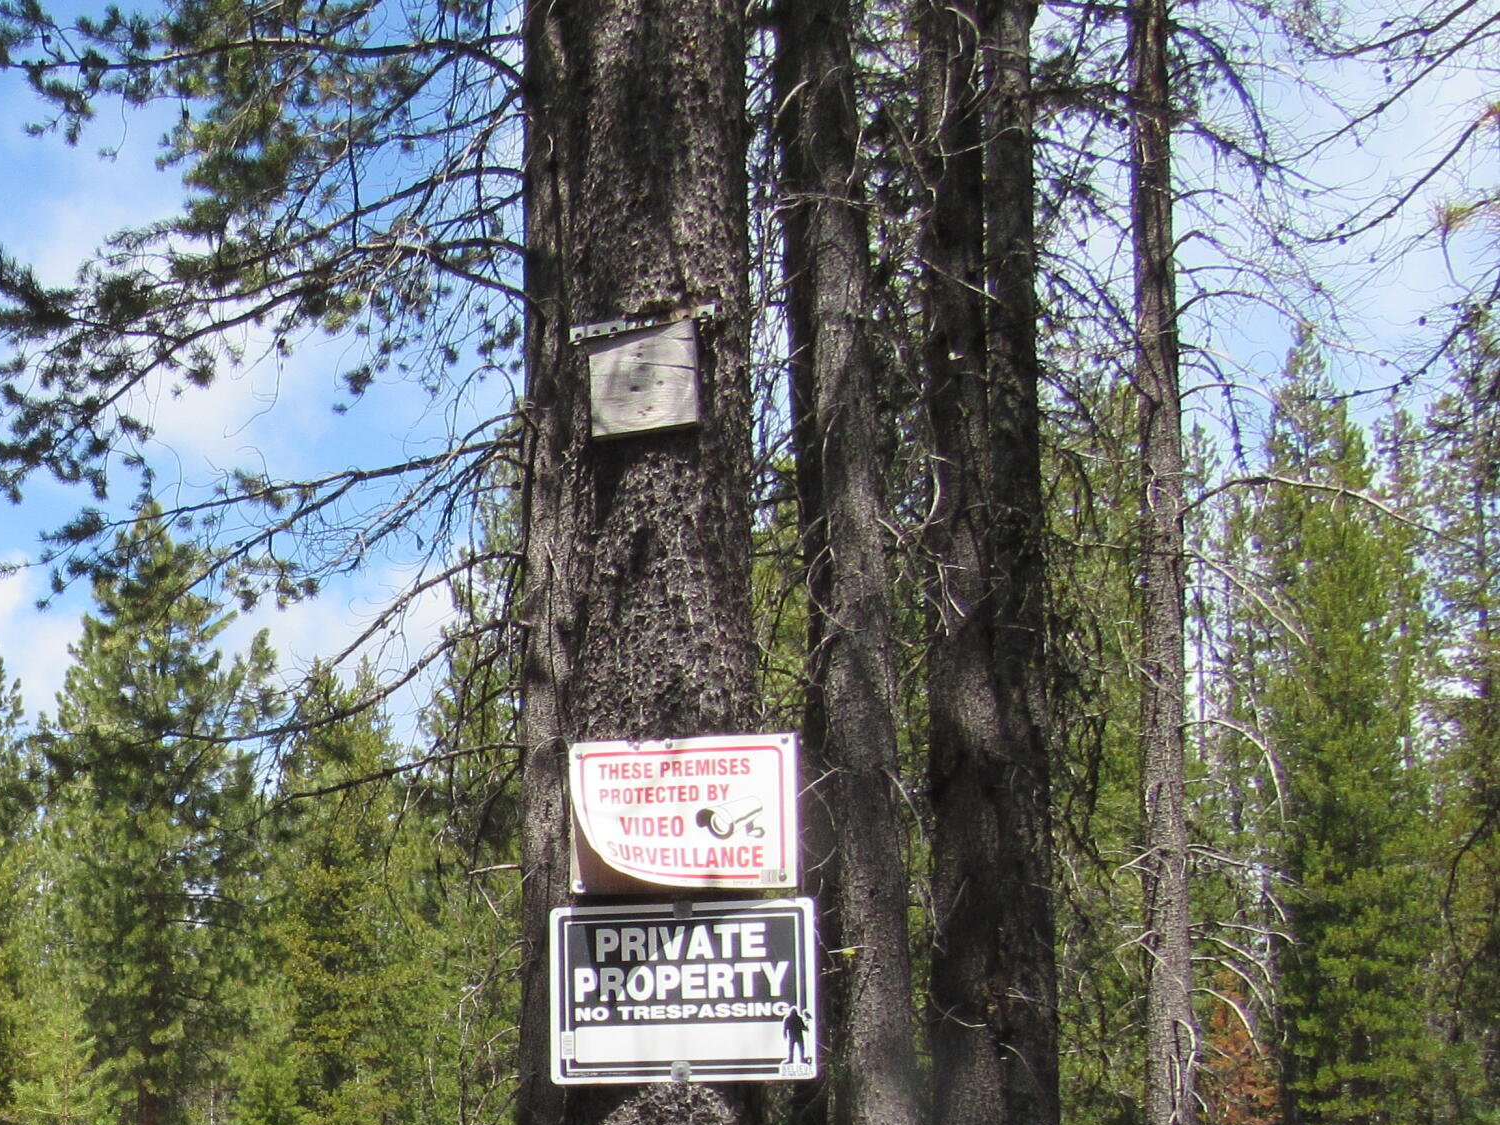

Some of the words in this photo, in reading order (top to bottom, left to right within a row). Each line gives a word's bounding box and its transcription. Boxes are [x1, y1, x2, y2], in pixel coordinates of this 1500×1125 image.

[598, 761, 653, 780] THESE
[660, 757, 751, 778] PREMISES
[599, 785, 699, 805] PROTECTED
[707, 783, 730, 801] BY
[619, 815, 684, 837] VIDEO
[607, 840, 764, 868] SURVEILLANCE
[596, 923, 766, 962] PRIVATE
[574, 961, 789, 1003] PROPERTY
[575, 1007, 610, 1022] NO
[617, 1001, 790, 1021] TRESPASSING
